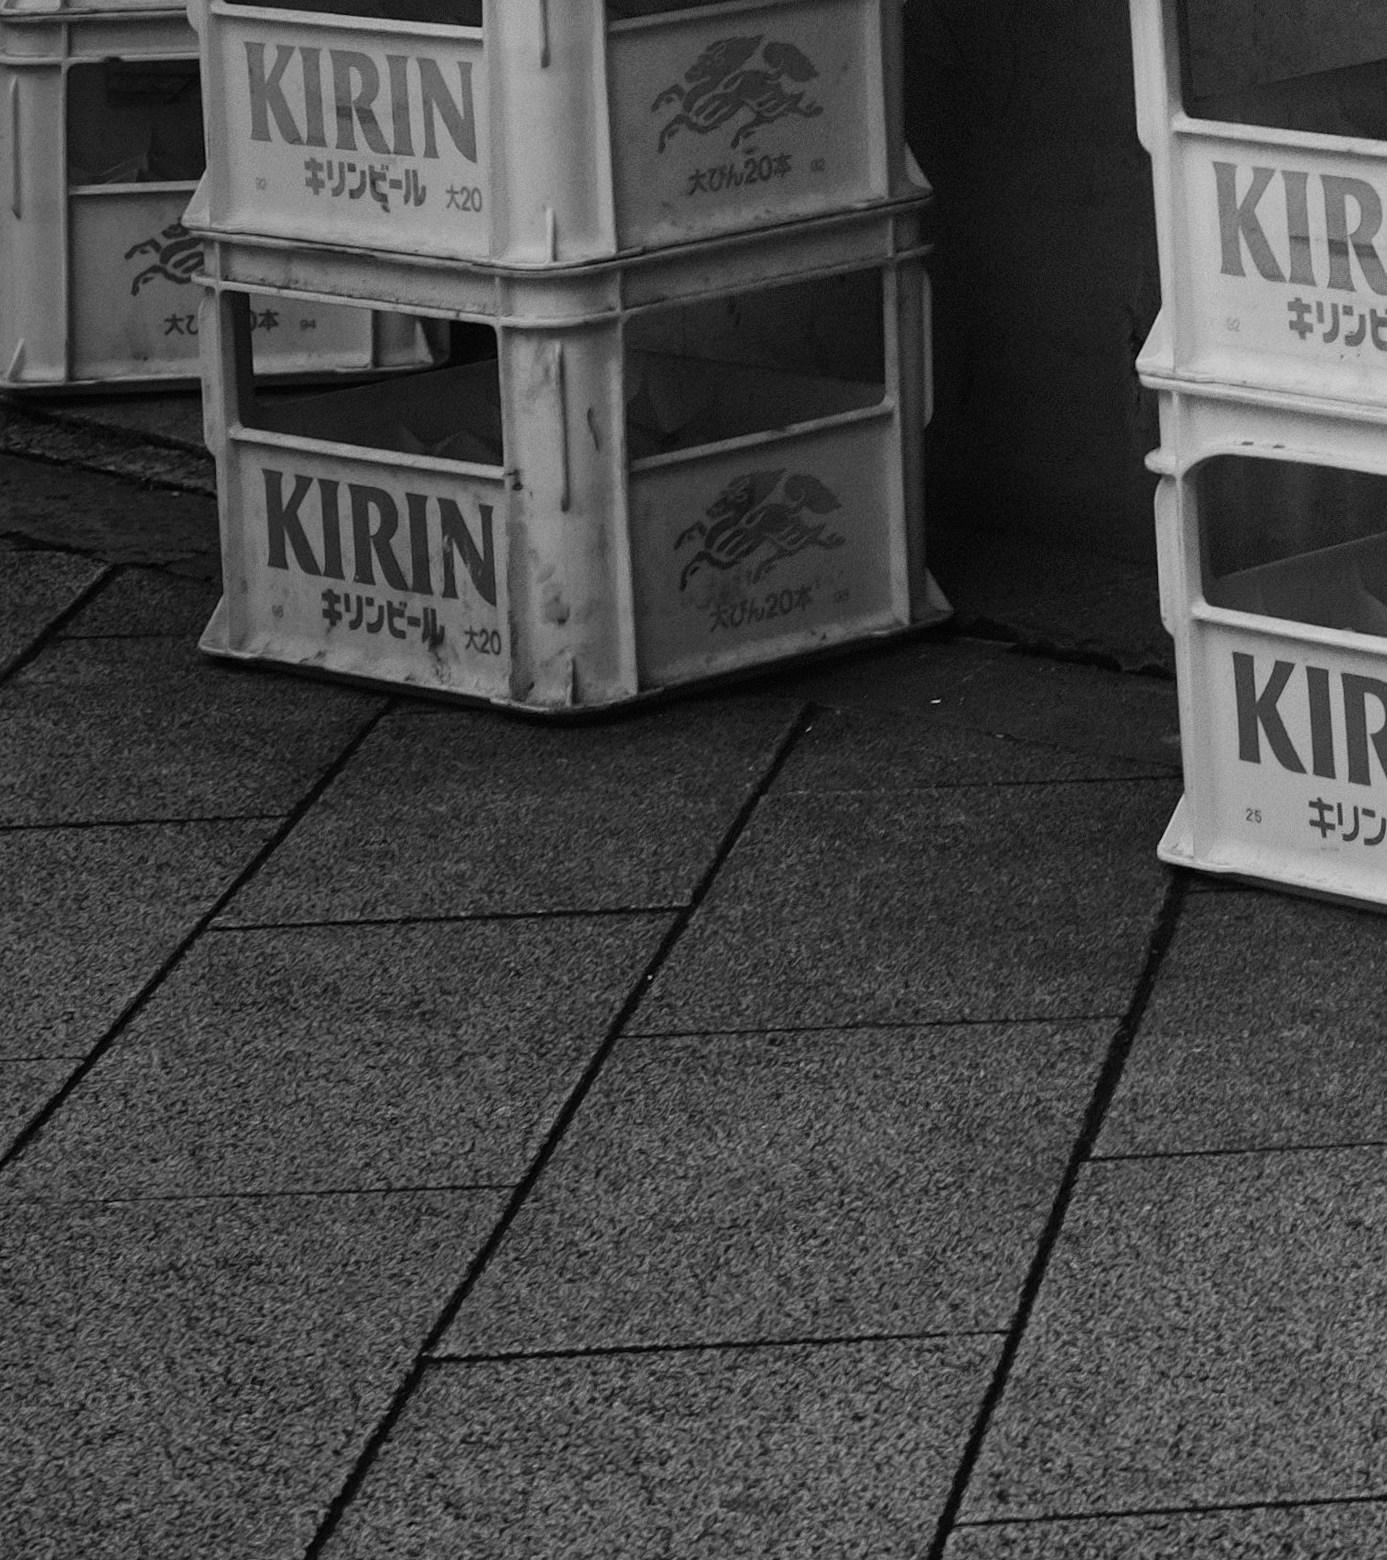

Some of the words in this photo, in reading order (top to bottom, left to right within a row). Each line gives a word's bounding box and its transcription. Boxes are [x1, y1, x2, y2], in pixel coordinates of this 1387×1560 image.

[244, 41, 478, 164] KIRIN
[303, 156, 427, 208] キリンビール
[686, 152, 792, 197] 大びん20本
[261, 467, 499, 609] KIRIN
[320, 588, 446, 646] キリンビール
[709, 583, 812, 633] 大びん20本
